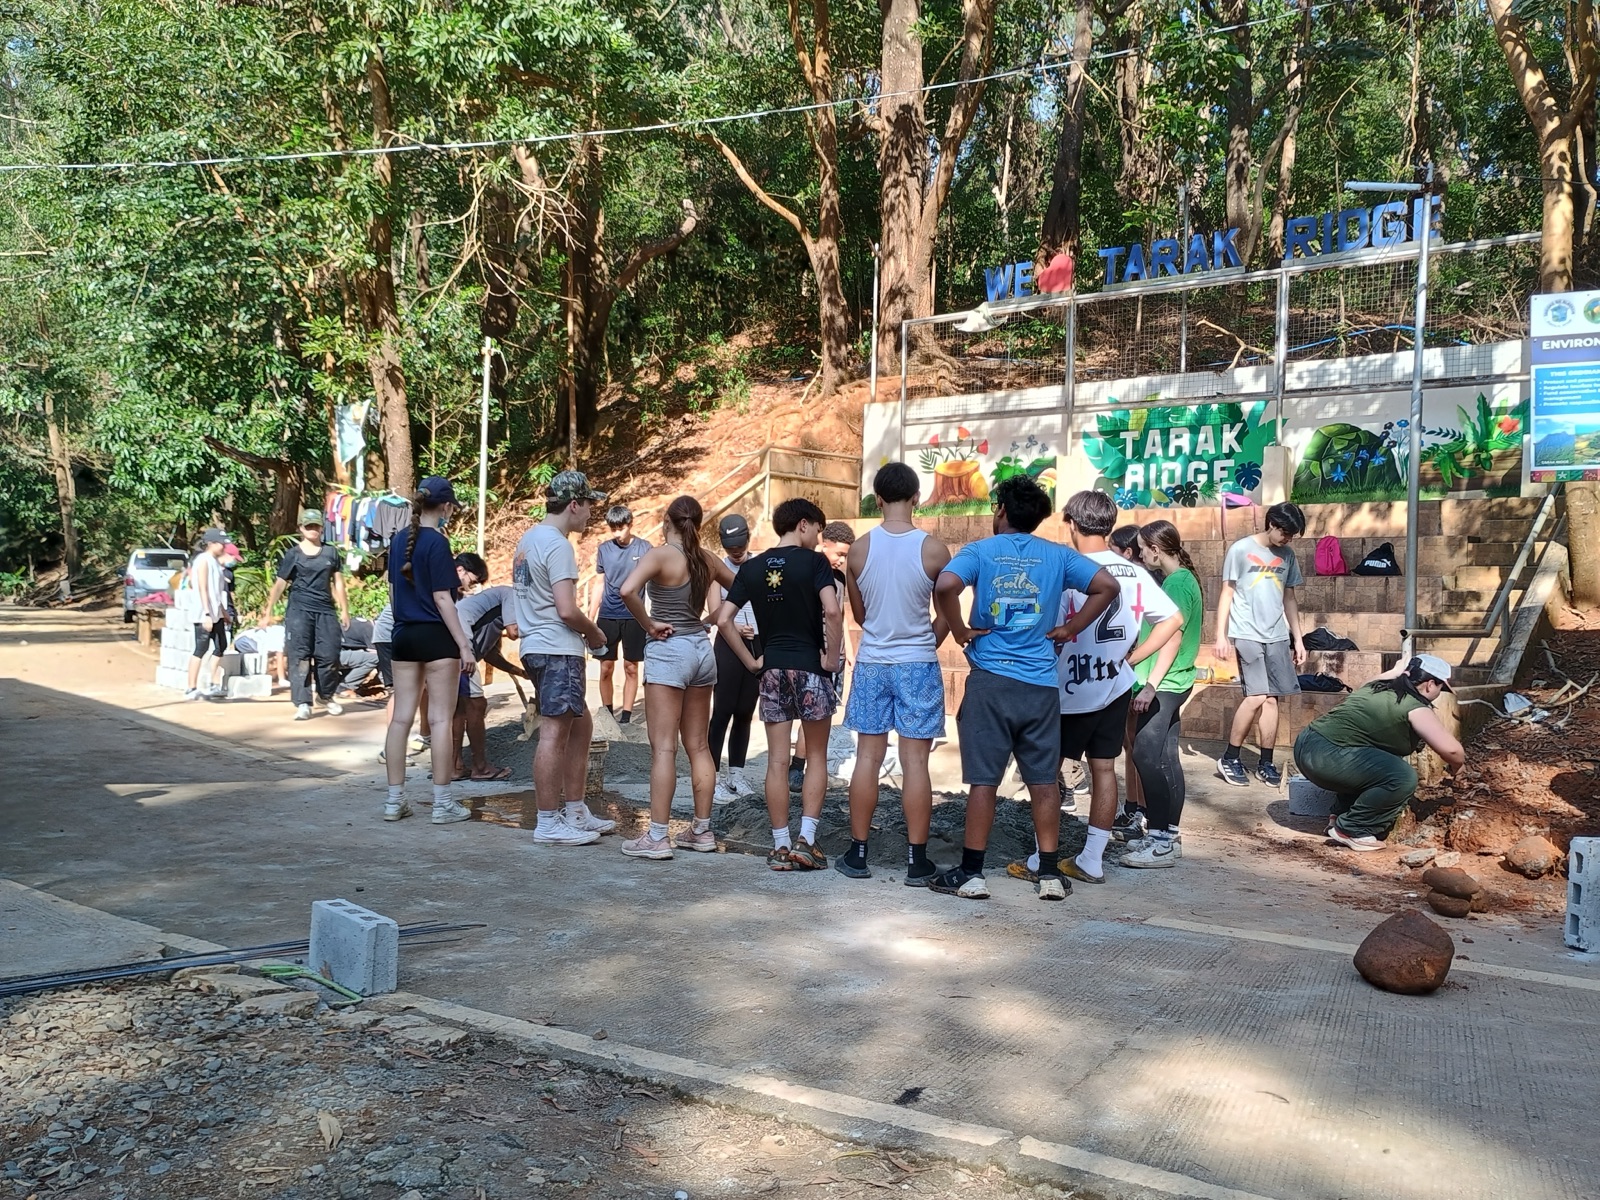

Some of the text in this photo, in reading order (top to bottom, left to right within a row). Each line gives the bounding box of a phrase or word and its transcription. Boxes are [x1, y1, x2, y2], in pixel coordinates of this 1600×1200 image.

[984, 196, 1441, 303] WE TARAK RIDGE
[1542, 337, 1600, 350] ENVIRON
[1119, 422, 1244, 492] TARAK RIDGE
[1247, 565, 1286, 575] NIKE
[1364, 559, 1387, 569] PUMA
[1095, 591, 1127, 644] 2
